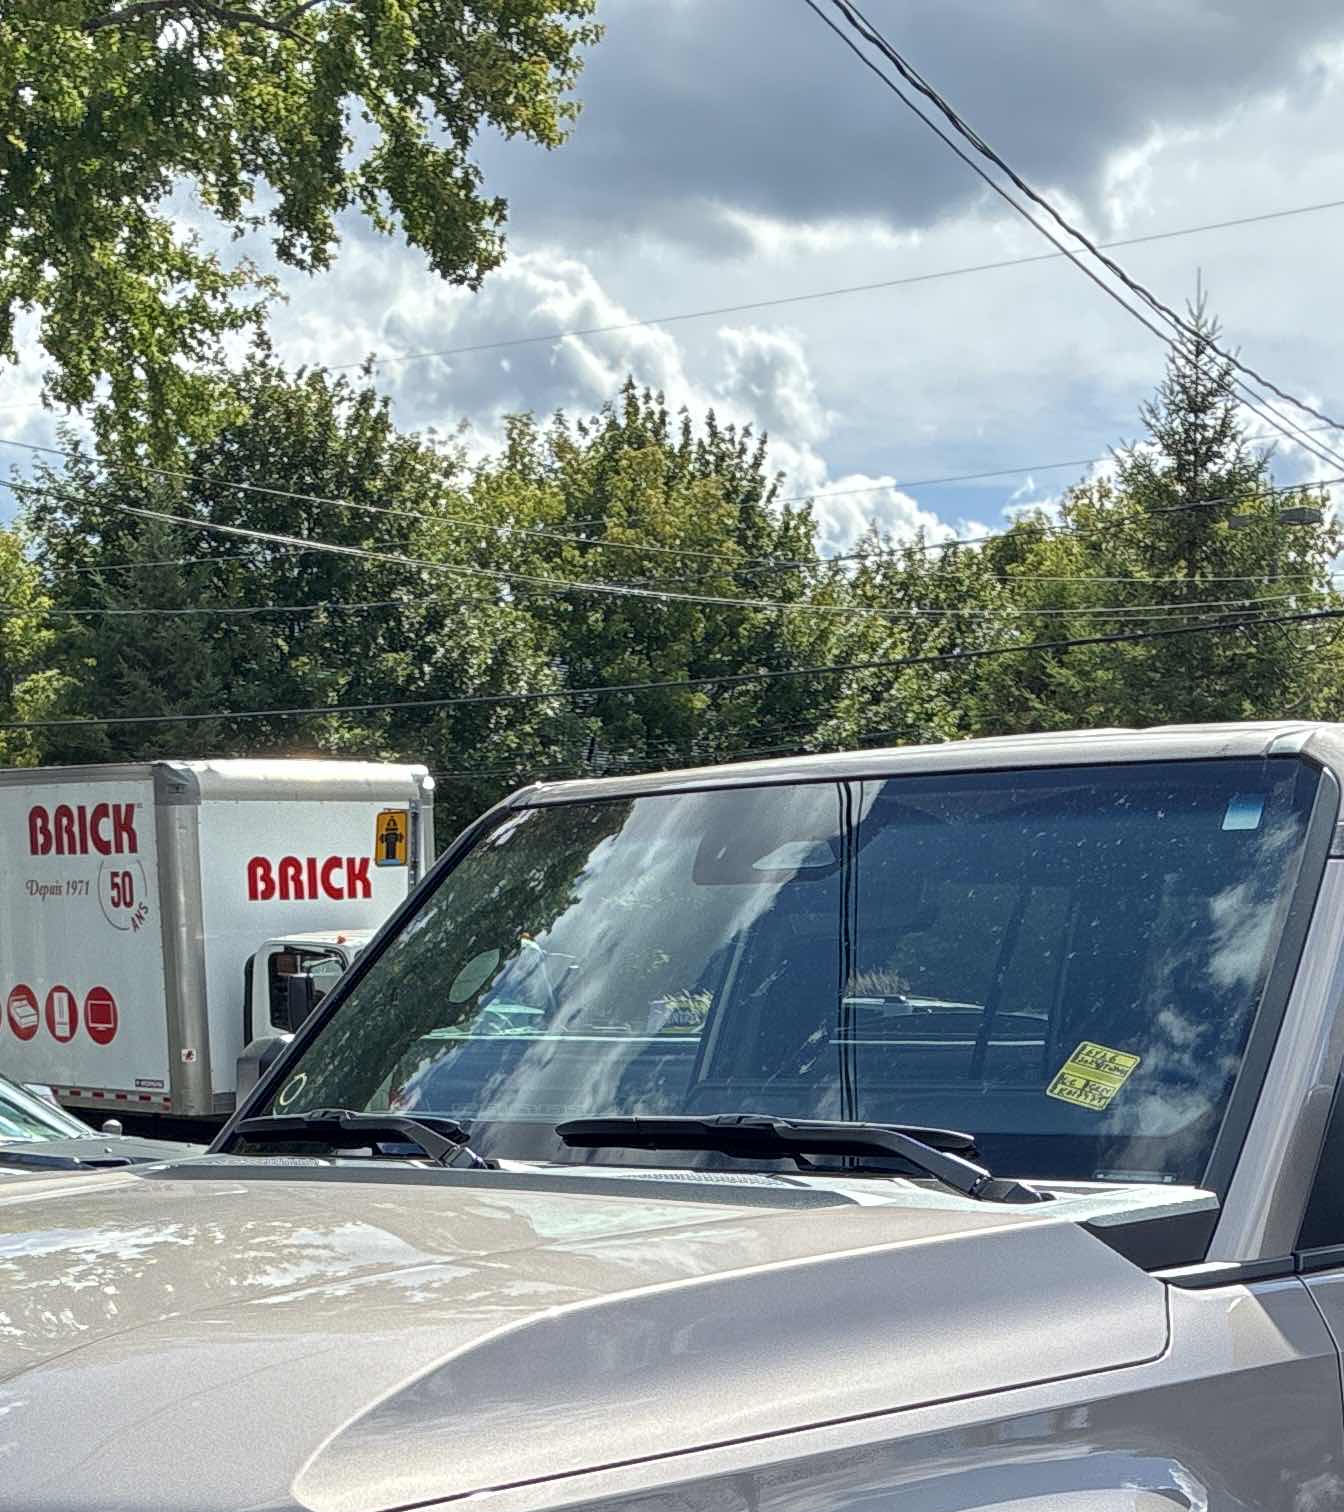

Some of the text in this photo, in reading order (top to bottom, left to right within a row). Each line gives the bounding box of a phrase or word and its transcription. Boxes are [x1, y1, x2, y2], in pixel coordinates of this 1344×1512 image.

[28, 803, 138, 855] BRICK
[25, 879, 89, 902] Depuis 1971
[110, 870, 134, 908] 50
[247, 856, 372, 900] BRICK
[130, 901, 149, 932] ANS
